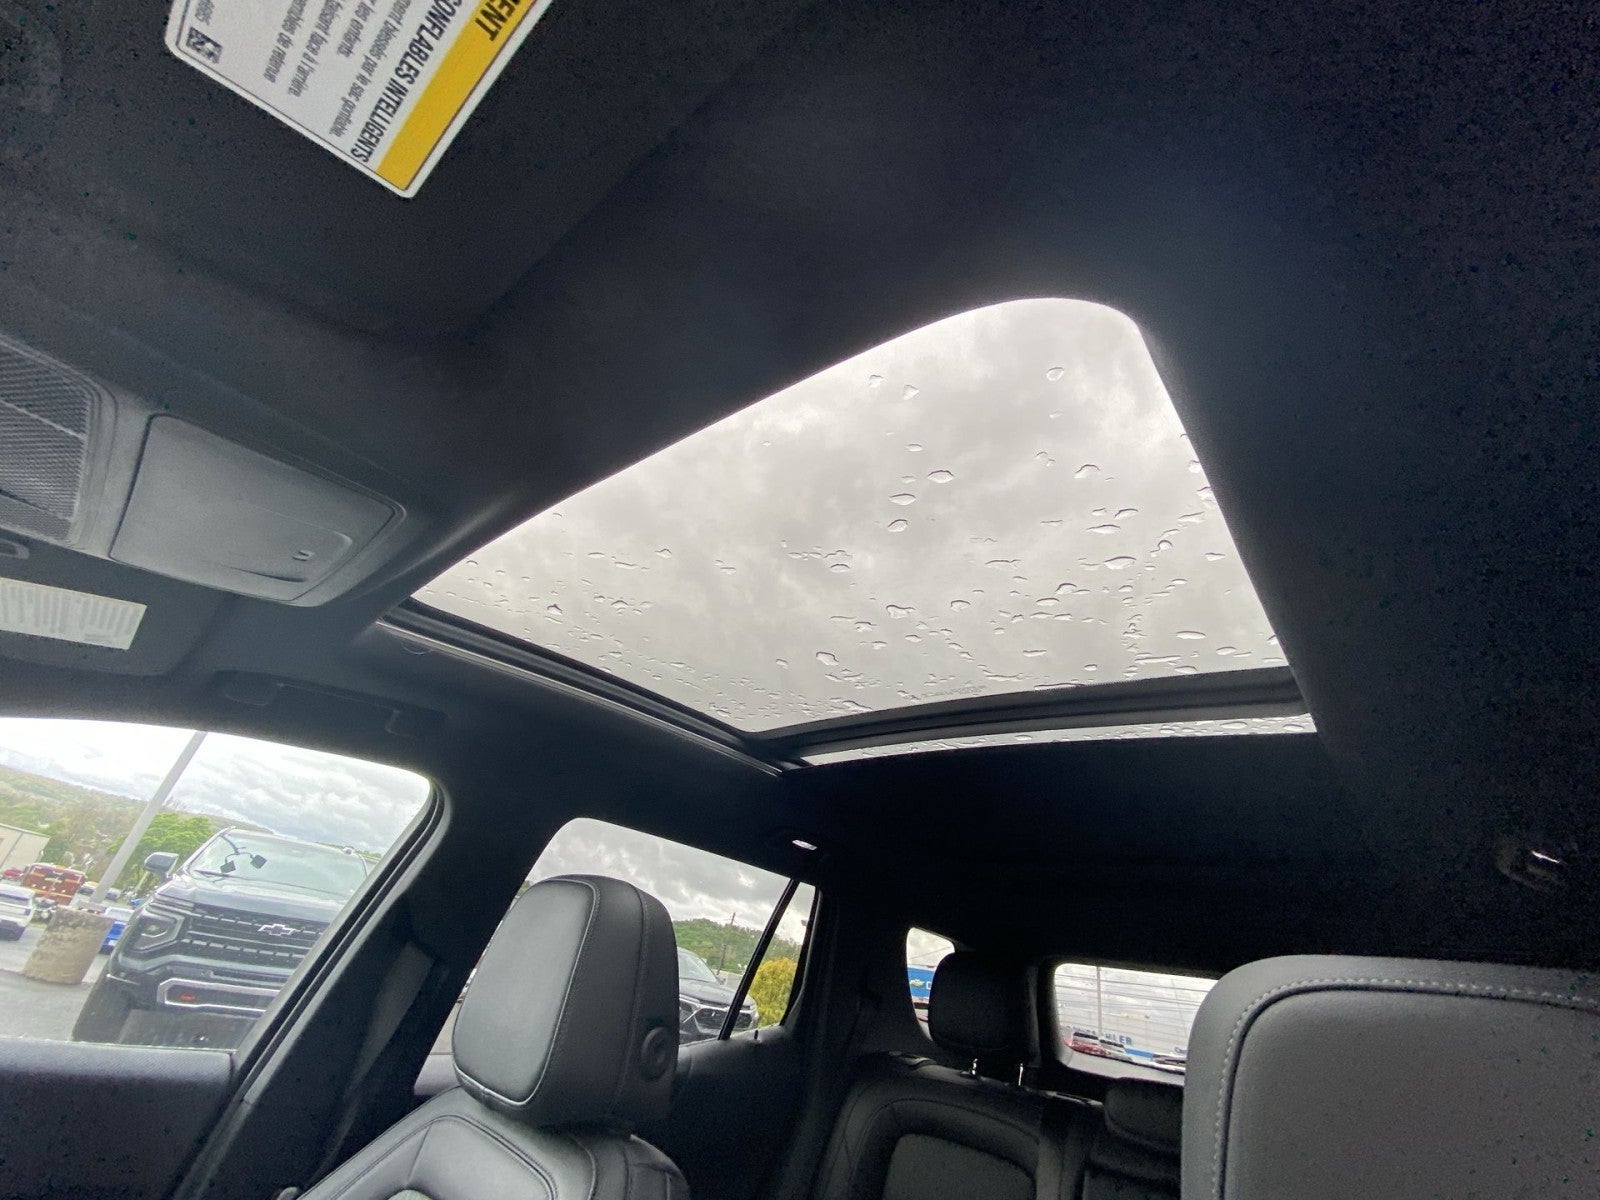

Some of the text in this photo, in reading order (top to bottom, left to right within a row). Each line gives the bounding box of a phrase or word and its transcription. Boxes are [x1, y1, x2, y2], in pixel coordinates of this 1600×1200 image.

[475, 0, 520, 41] ENT
[276, 32, 293, 49] de
[306, 31, 328, 56] face
[370, 20, 399, 61] blessés
[263, 46, 287, 83] retenue
[361, 54, 378, 77] par
[356, 72, 372, 86] le
[348, 82, 365, 102] sac
[351, 78, 409, 162] INTELLIGENTS
